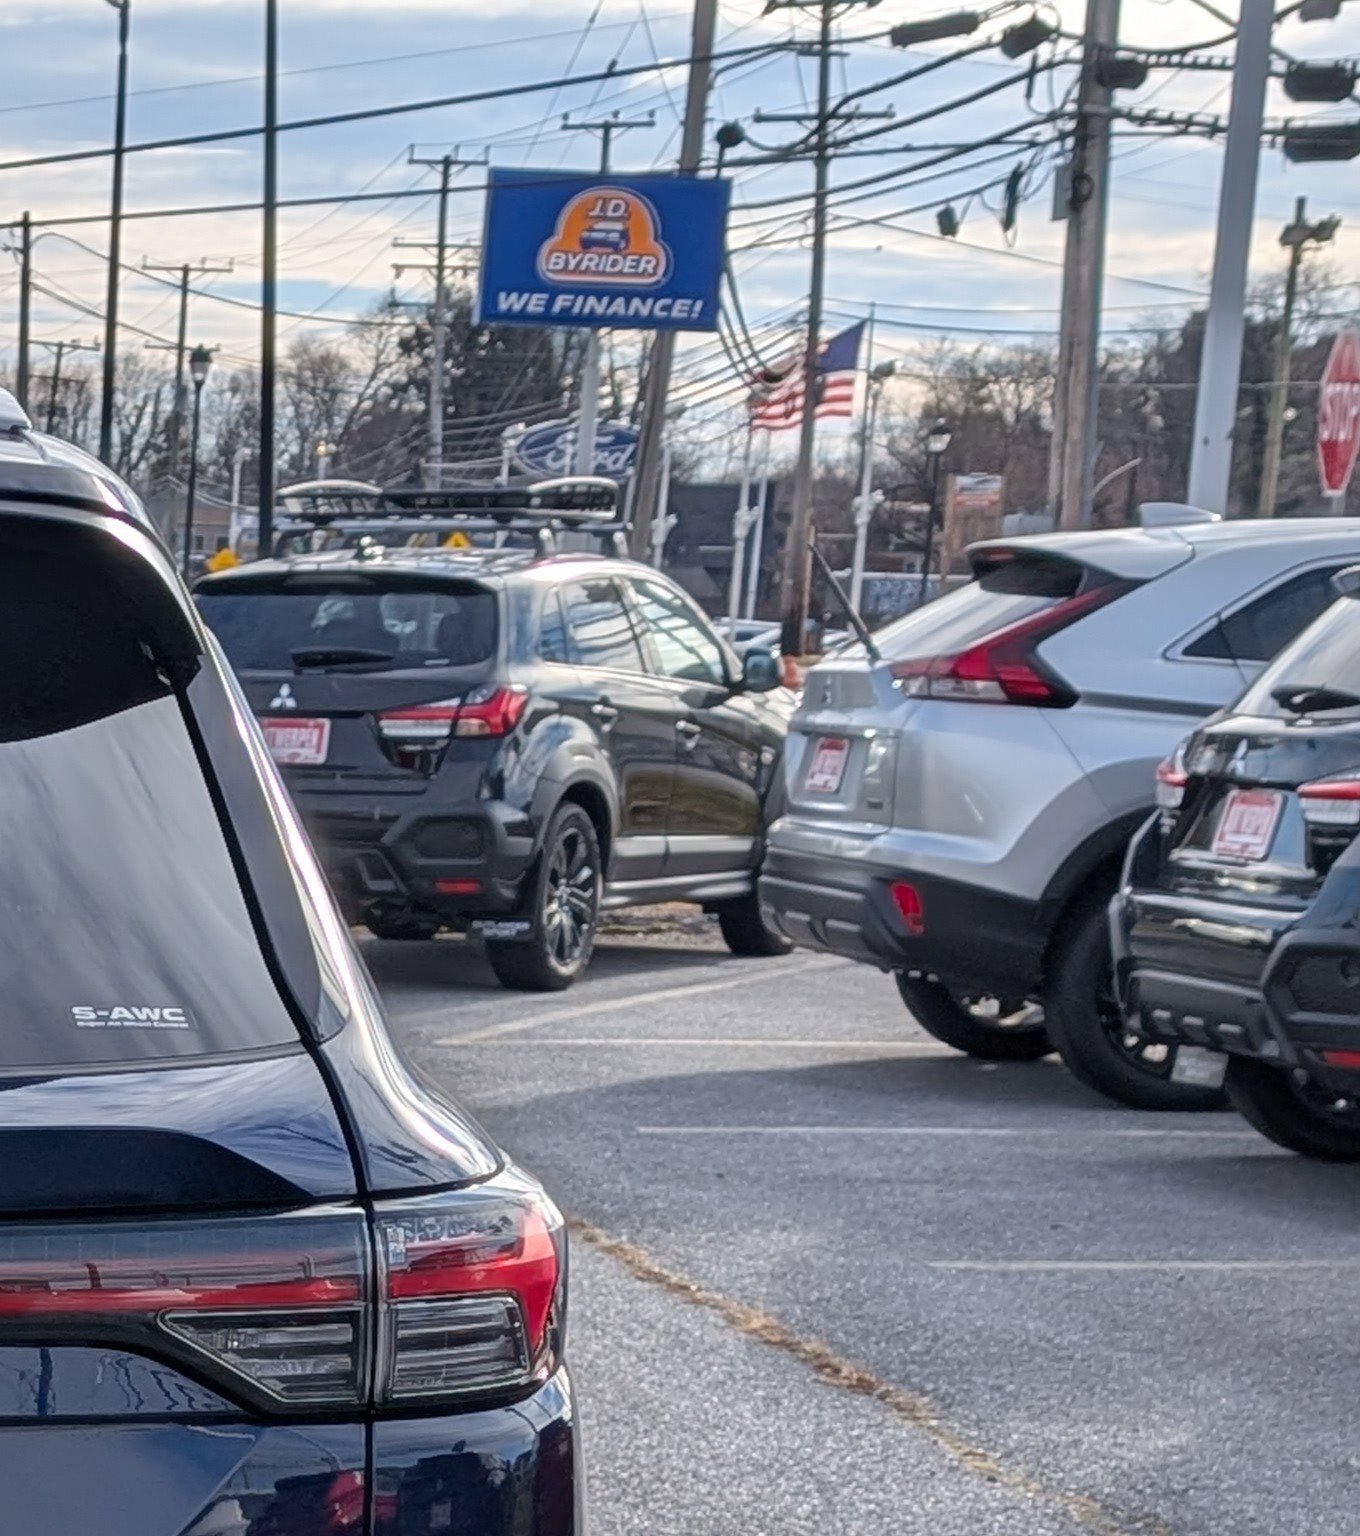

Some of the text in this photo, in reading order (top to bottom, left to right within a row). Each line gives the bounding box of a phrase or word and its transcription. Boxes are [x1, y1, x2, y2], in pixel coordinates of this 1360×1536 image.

[588, 199, 627, 217] J.D.
[548, 252, 658, 274] BYRIDER
[497, 291, 705, 320] WE FINANCE!
[72, 1006, 186, 1022] S-AWC
